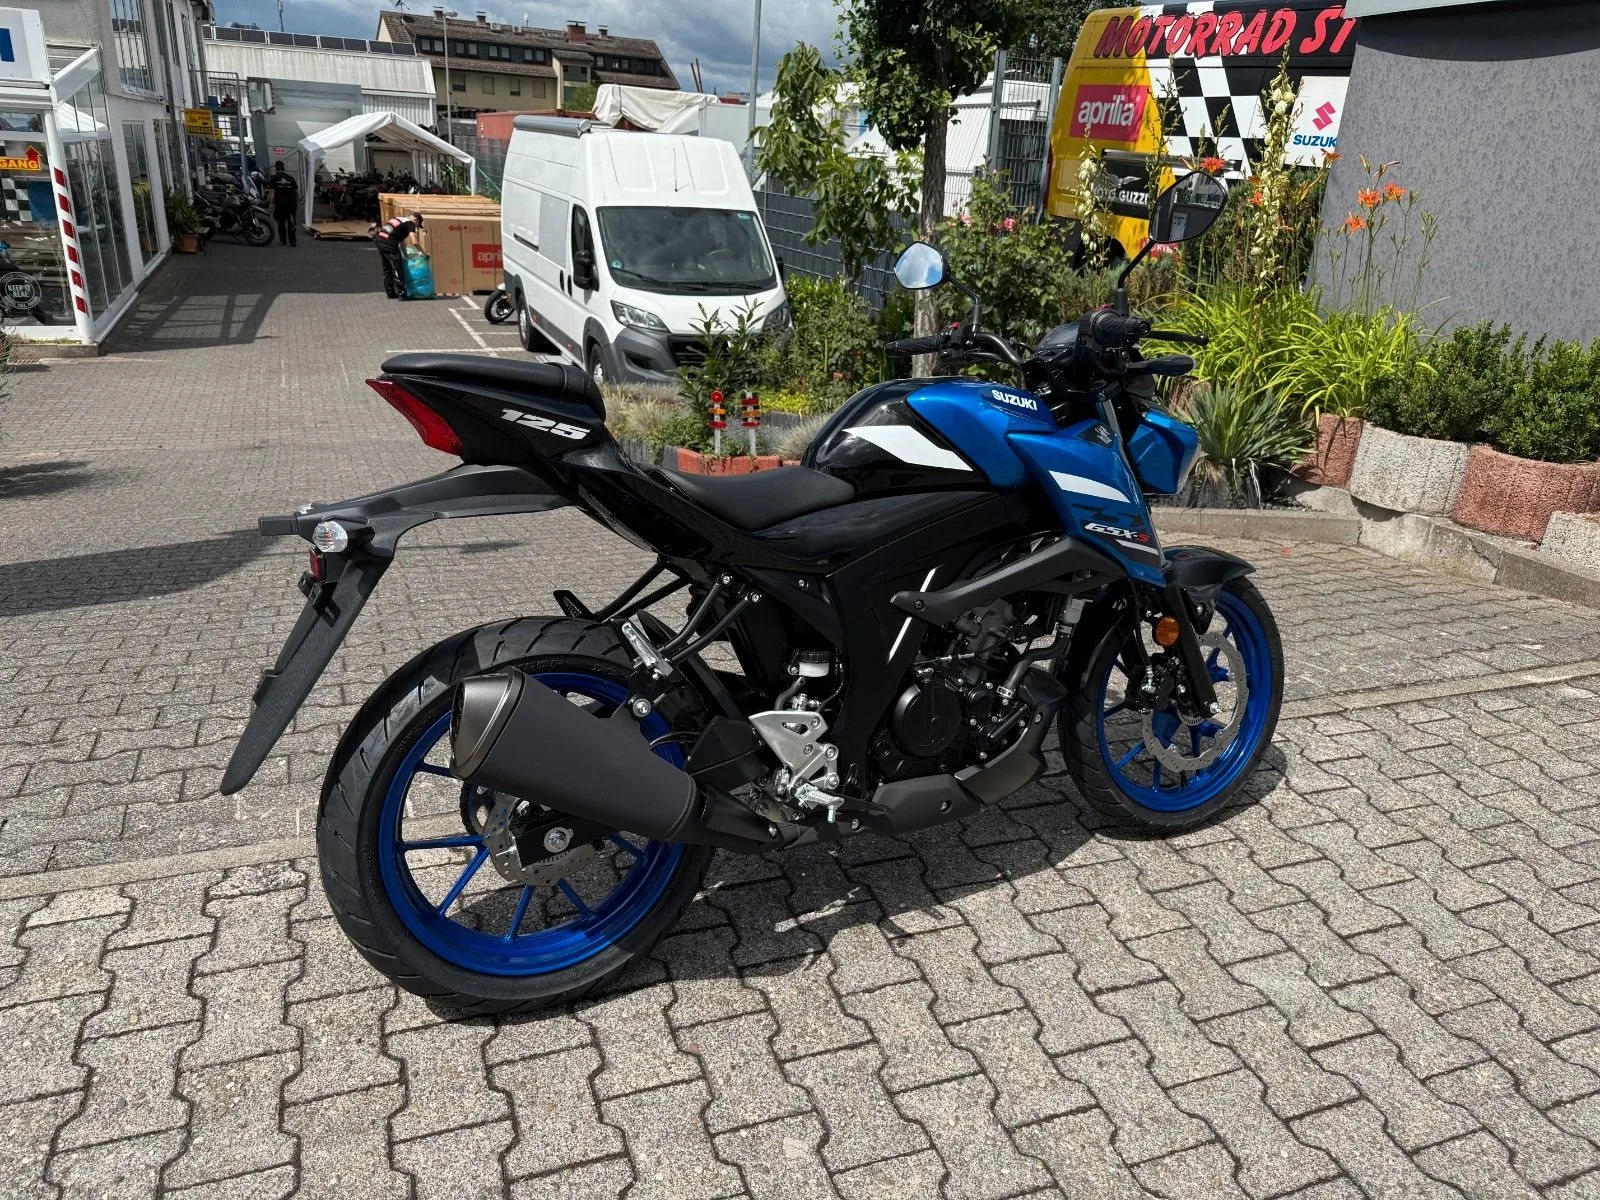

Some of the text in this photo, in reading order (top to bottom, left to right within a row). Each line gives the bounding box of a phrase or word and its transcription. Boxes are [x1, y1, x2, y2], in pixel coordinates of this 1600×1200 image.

[1093, 7, 1297, 59] MOTORRAD
[1078, 94, 1134, 129] aprilia
[1118, 189, 1148, 206] GUZZI
[7, 284, 24, 292] KEEP
[12, 290, 29, 298] REAL
[991, 389, 1038, 411] SUZUKI
[500, 407, 591, 440] 125
[1084, 522, 1151, 543] GSX-S
